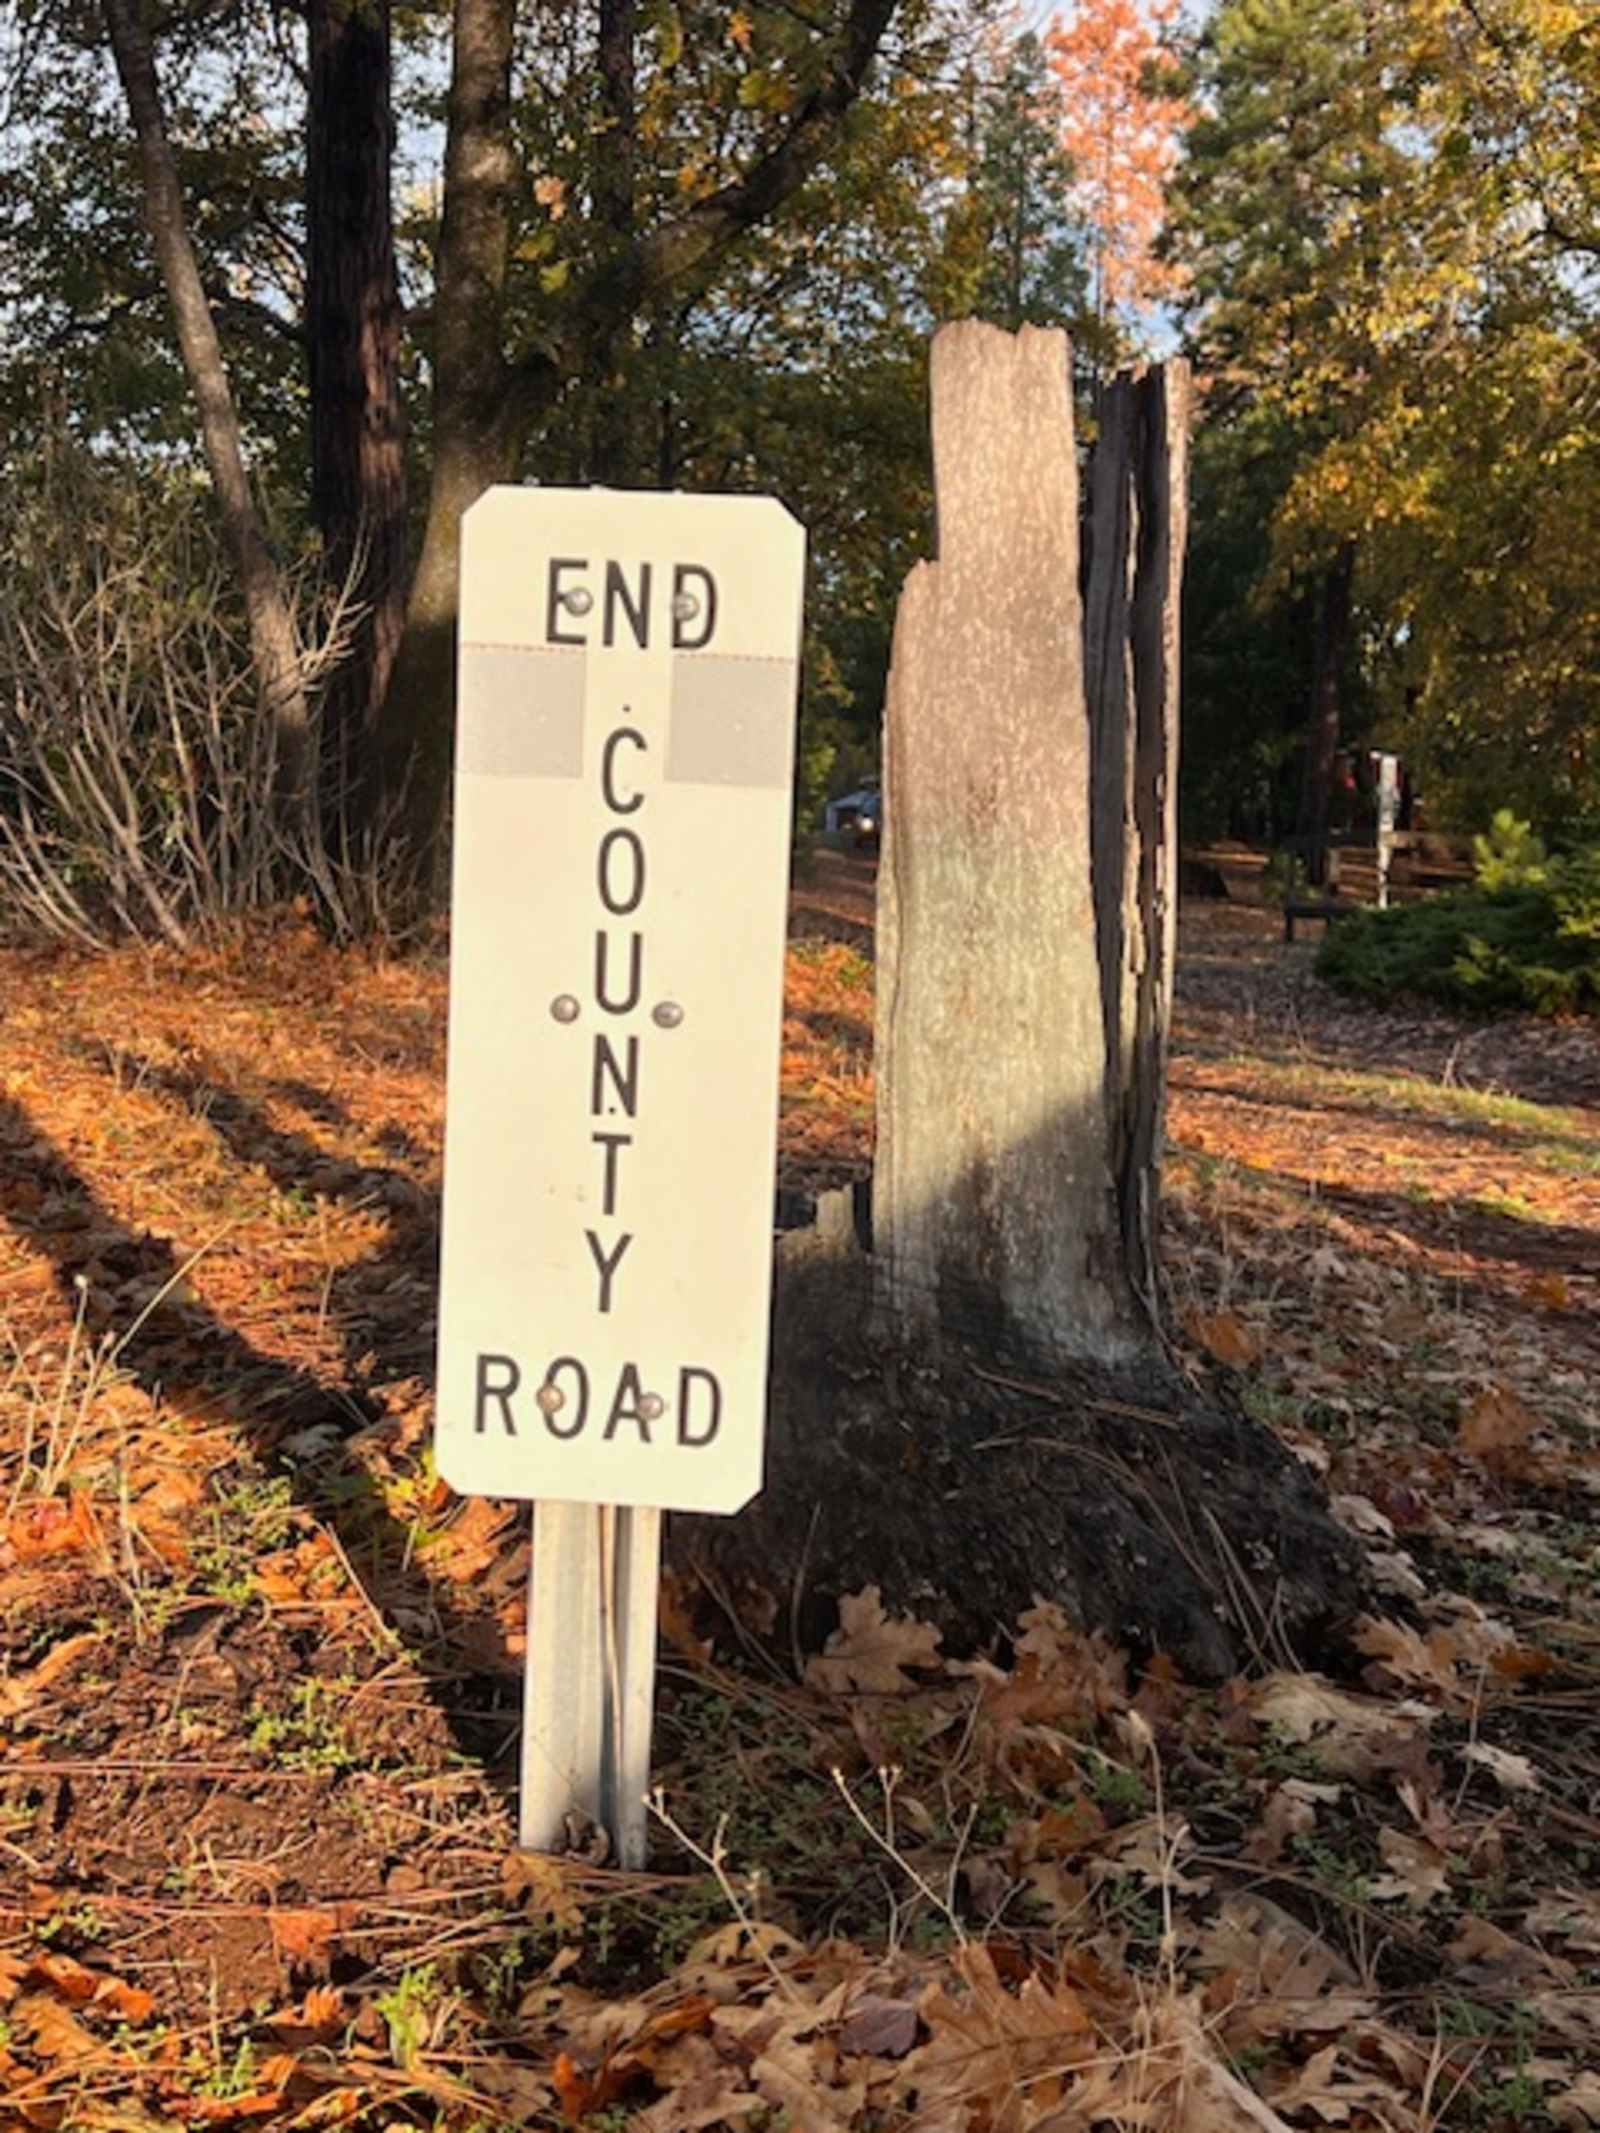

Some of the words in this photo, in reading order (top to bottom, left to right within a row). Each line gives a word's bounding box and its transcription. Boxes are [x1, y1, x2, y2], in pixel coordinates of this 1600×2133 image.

[546, 557, 718, 650] END
[585, 727, 647, 1314] COUNTY
[474, 1354, 722, 1447] ROAD
